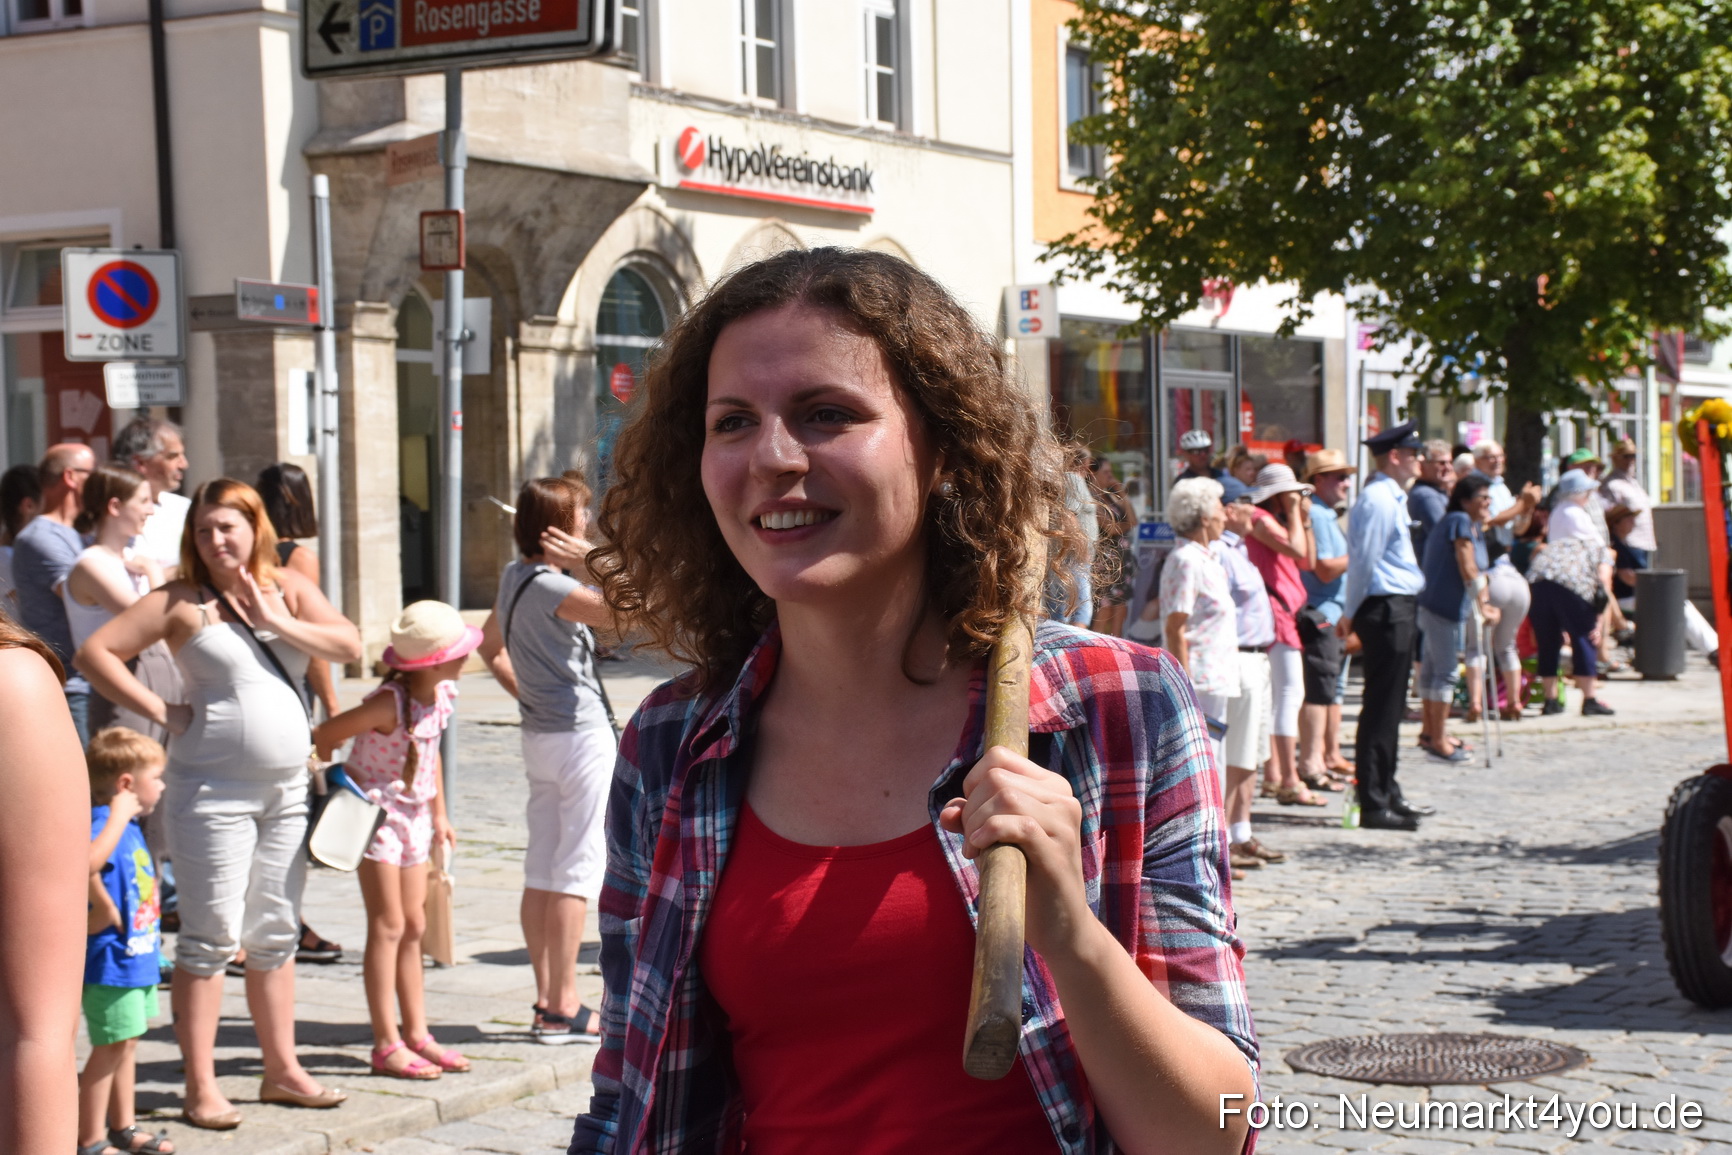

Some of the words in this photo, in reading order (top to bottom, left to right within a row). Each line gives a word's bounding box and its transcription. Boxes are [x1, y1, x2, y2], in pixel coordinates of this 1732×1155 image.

[414, 0, 541, 36] Rosengasse
[708, 134, 874, 193] HypoVereinsbank
[97, 333, 153, 352] ZONE
